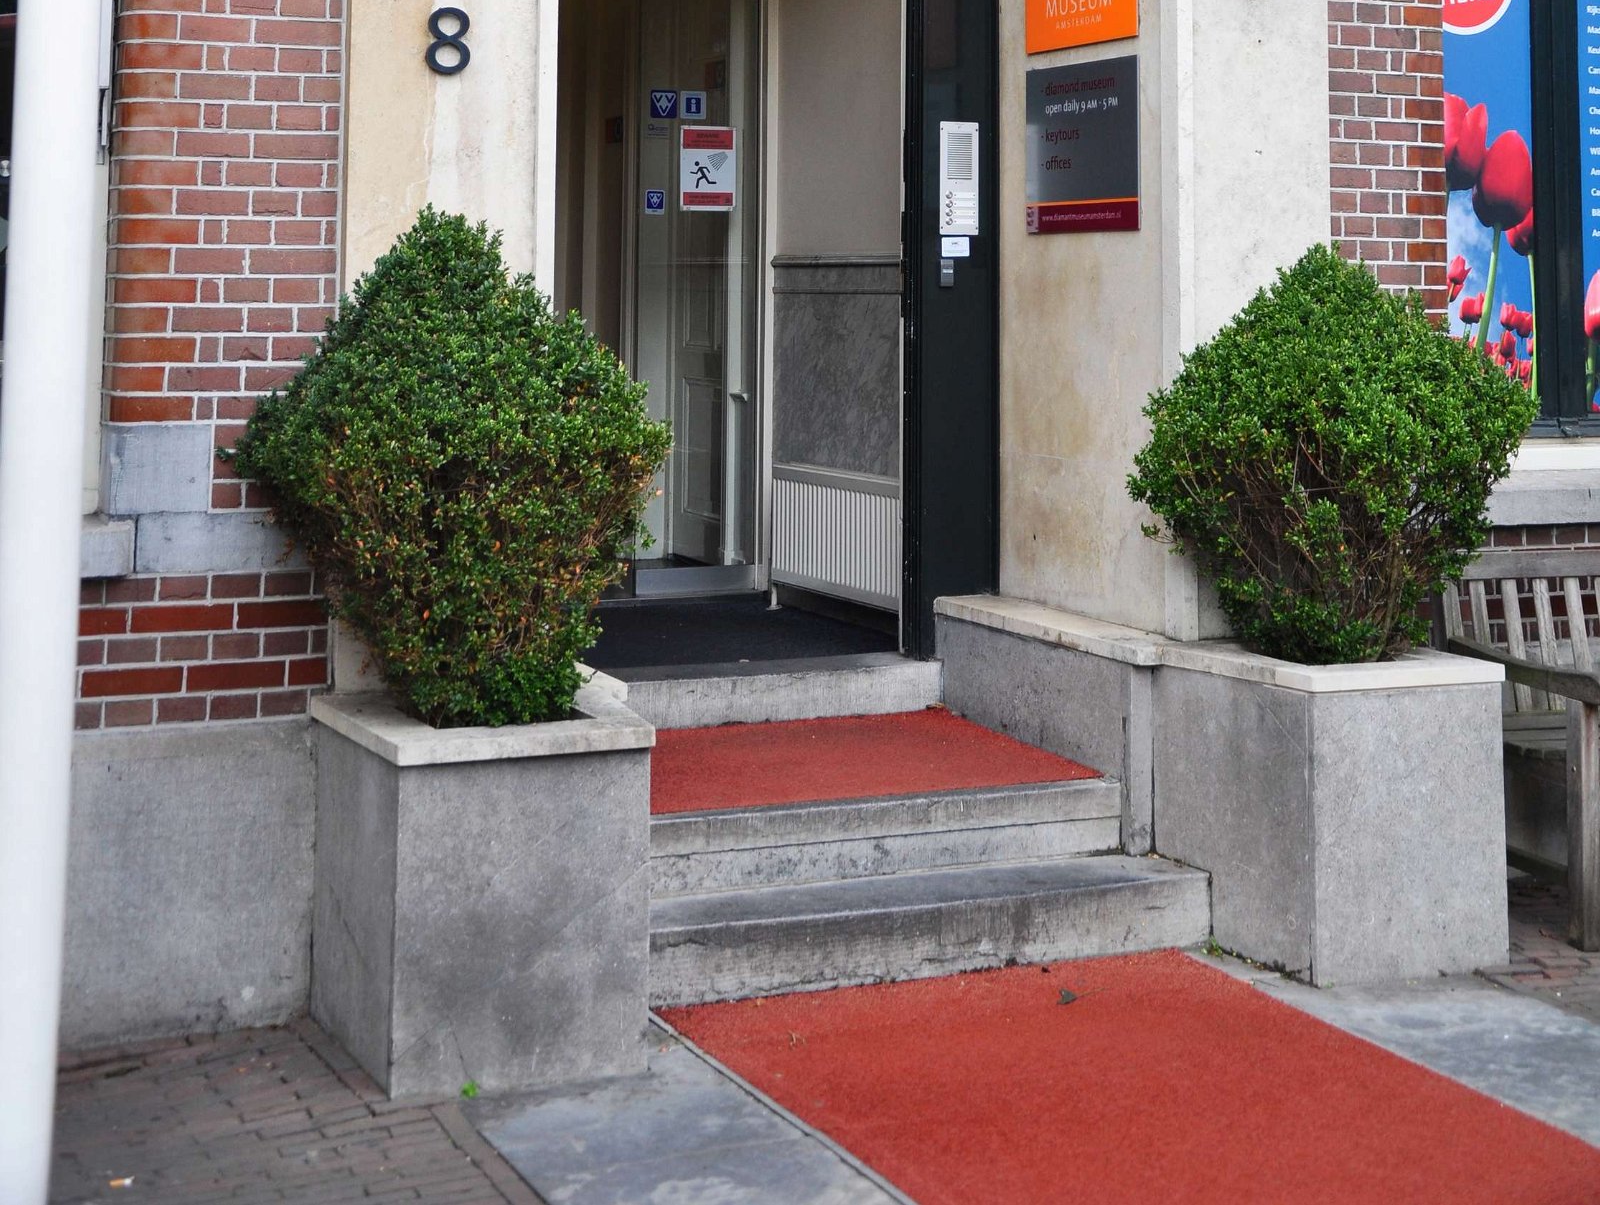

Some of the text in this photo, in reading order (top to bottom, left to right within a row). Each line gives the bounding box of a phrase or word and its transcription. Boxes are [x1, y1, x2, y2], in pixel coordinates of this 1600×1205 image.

[1056, 13, 1102, 30] AMSTERDAM
[425, 7, 470, 75] 8
[1045, 76, 1116, 96] diamond museum
[1045, 102, 1062, 116] open
[1063, 99, 1080, 114] daily
[1080, 101, 1086, 113] 9
[1086, 99, 1098, 109] AM
[1103, 98, 1107, 110] 5
[1108, 97, 1119, 107] PM
[1045, 128, 1080, 145] keytours
[1045, 155, 1072, 170] offices
